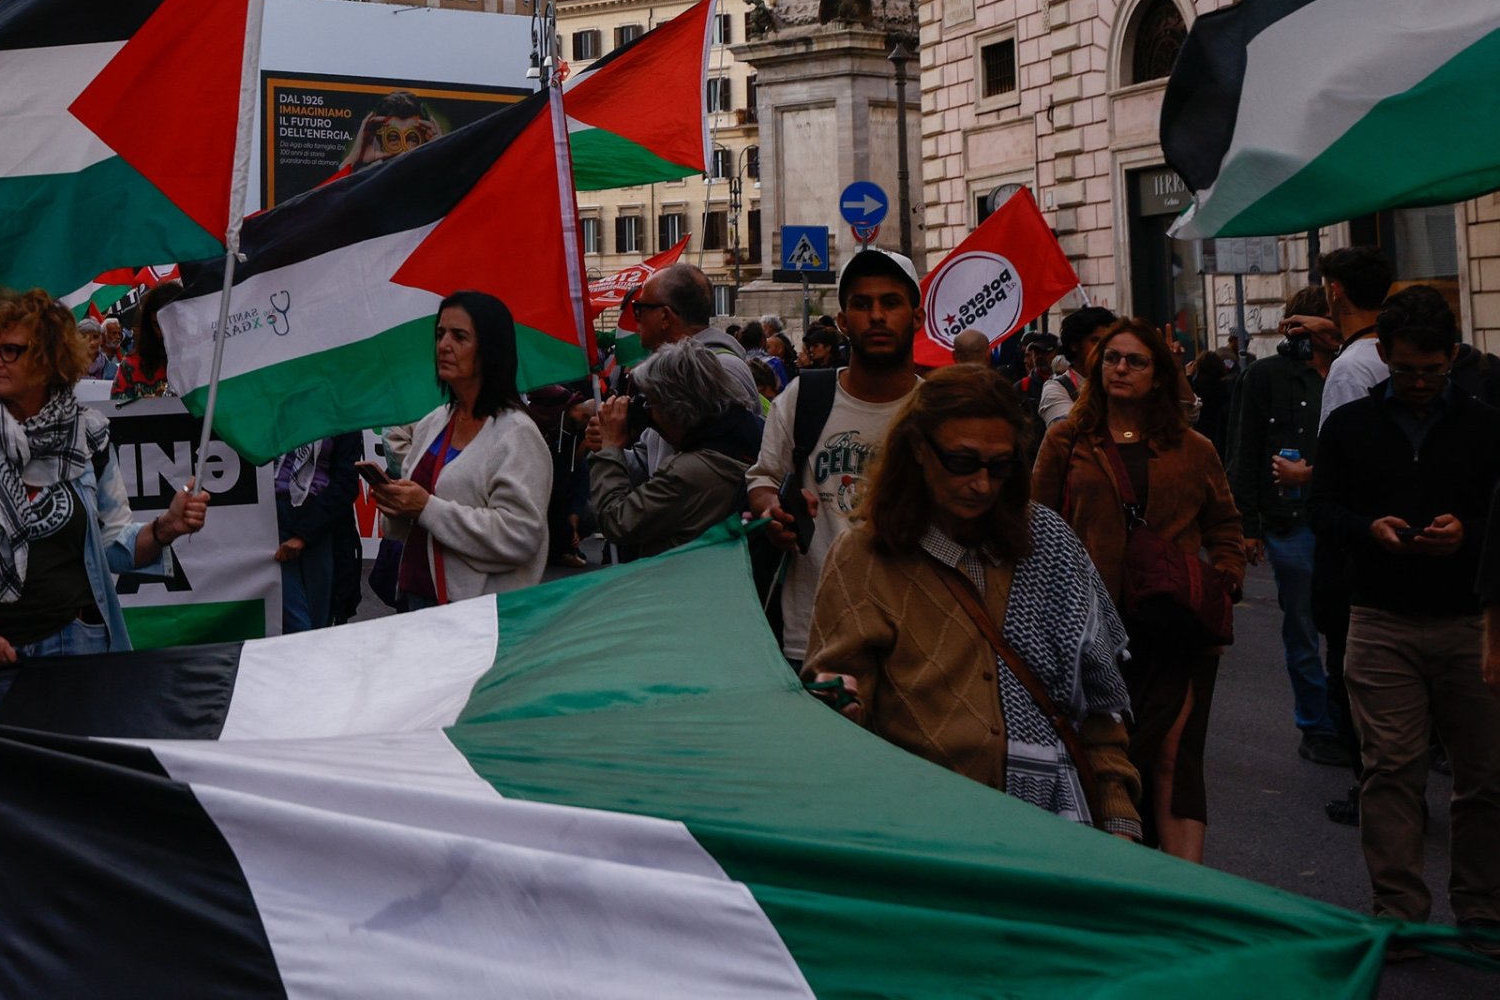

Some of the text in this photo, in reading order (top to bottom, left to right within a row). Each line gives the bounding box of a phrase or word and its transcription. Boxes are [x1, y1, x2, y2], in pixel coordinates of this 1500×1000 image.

[279, 94, 324, 106] DAL 1926
[279, 105, 352, 119] IMMAGINIAMO
[279, 116, 332, 128] IL FUTURO
[279, 127, 354, 141] DELL'ENERGIA.
[280, 140, 289, 148] Da
[290, 141, 303, 150] Agip
[314, 142, 337, 151] famiglia
